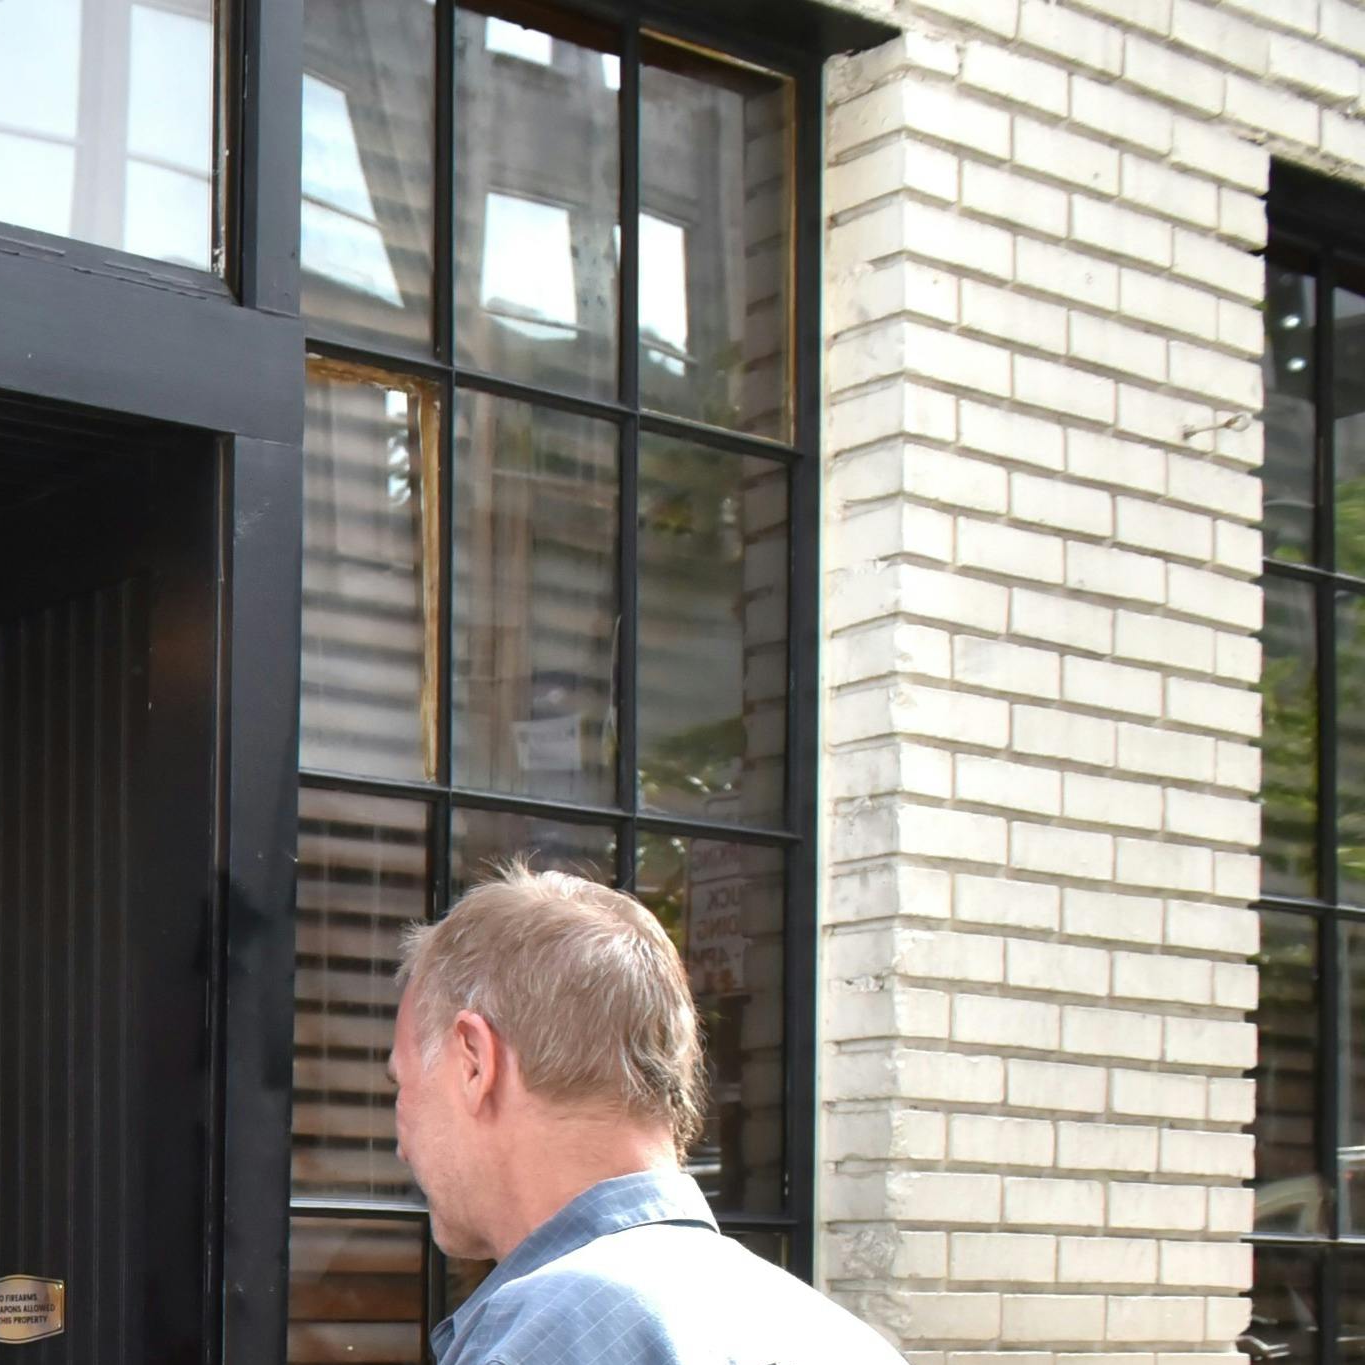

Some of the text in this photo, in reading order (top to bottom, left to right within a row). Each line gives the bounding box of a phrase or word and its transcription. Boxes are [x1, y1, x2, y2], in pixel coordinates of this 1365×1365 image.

[5, 1293, 38, 1302] FIREARMS
[23, 1304, 55, 1313] ALLOWED
[13, 1315, 48, 1324] PROPERTY
